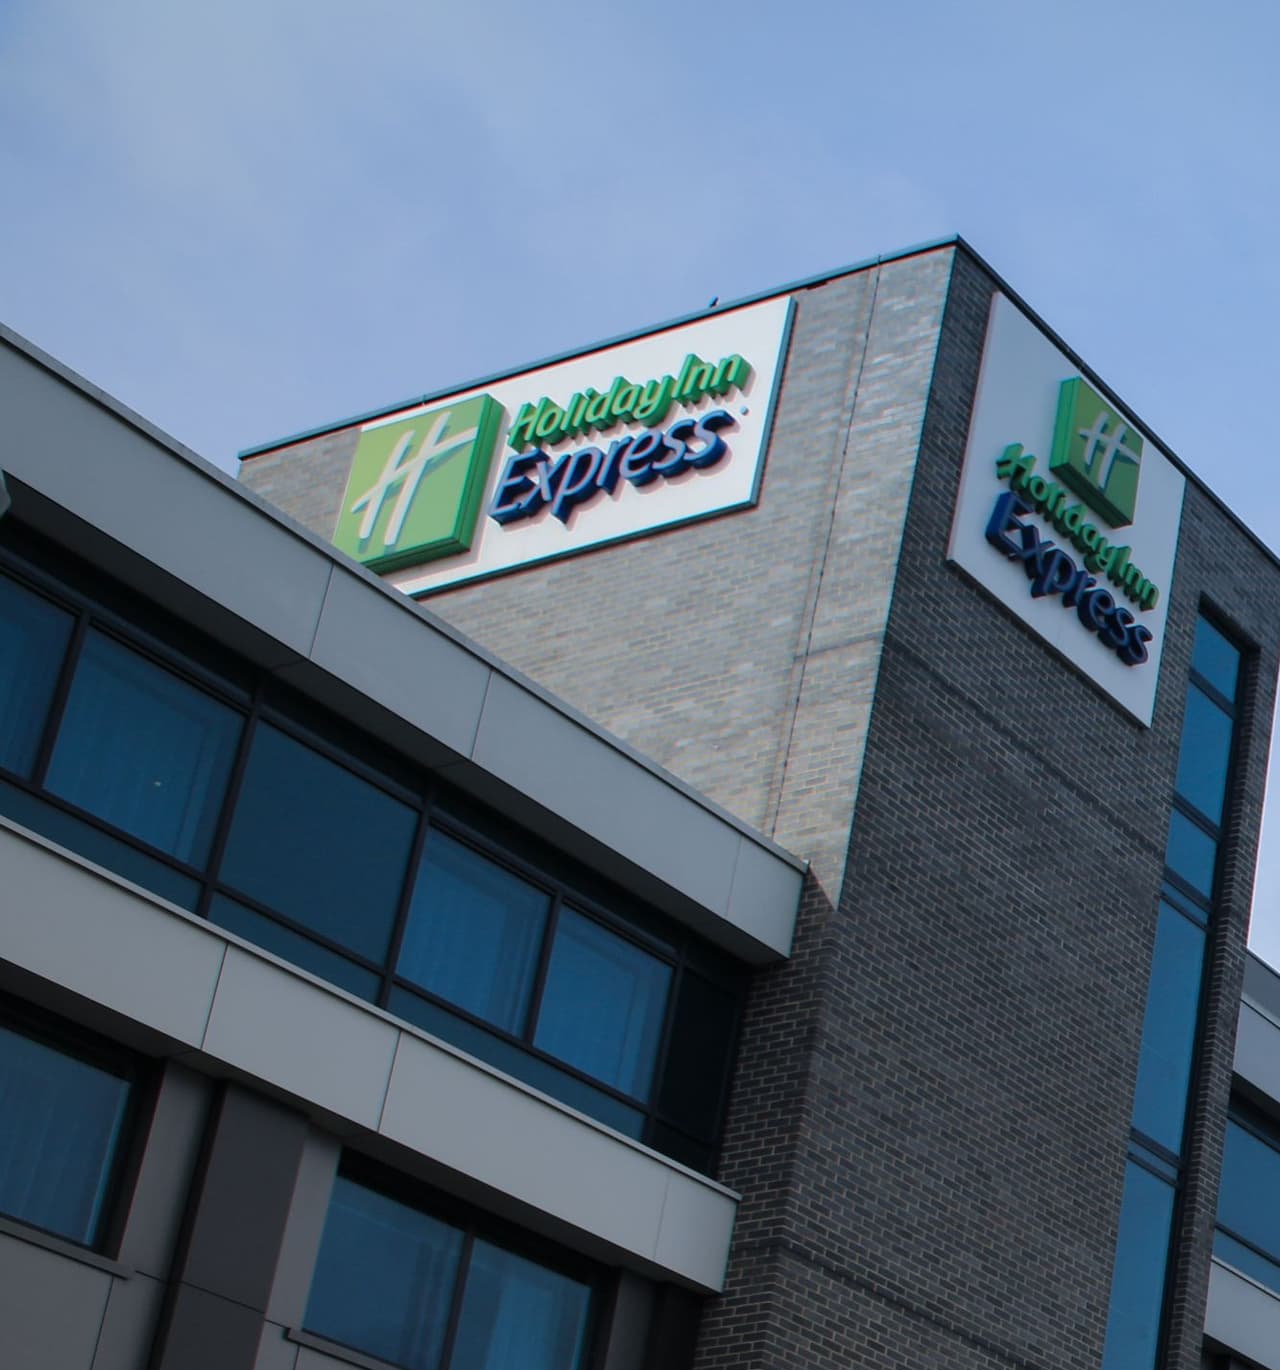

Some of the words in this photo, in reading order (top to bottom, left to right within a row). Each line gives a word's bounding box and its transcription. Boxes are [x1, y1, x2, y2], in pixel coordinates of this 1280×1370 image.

[488, 409, 735, 524] Express
[507, 375, 673, 453] Holiday
[672, 354, 751, 406] Inn
[985, 491, 1153, 666] Express
[996, 443, 1117, 574] Holiday
[1111, 546, 1159, 611] Inn
